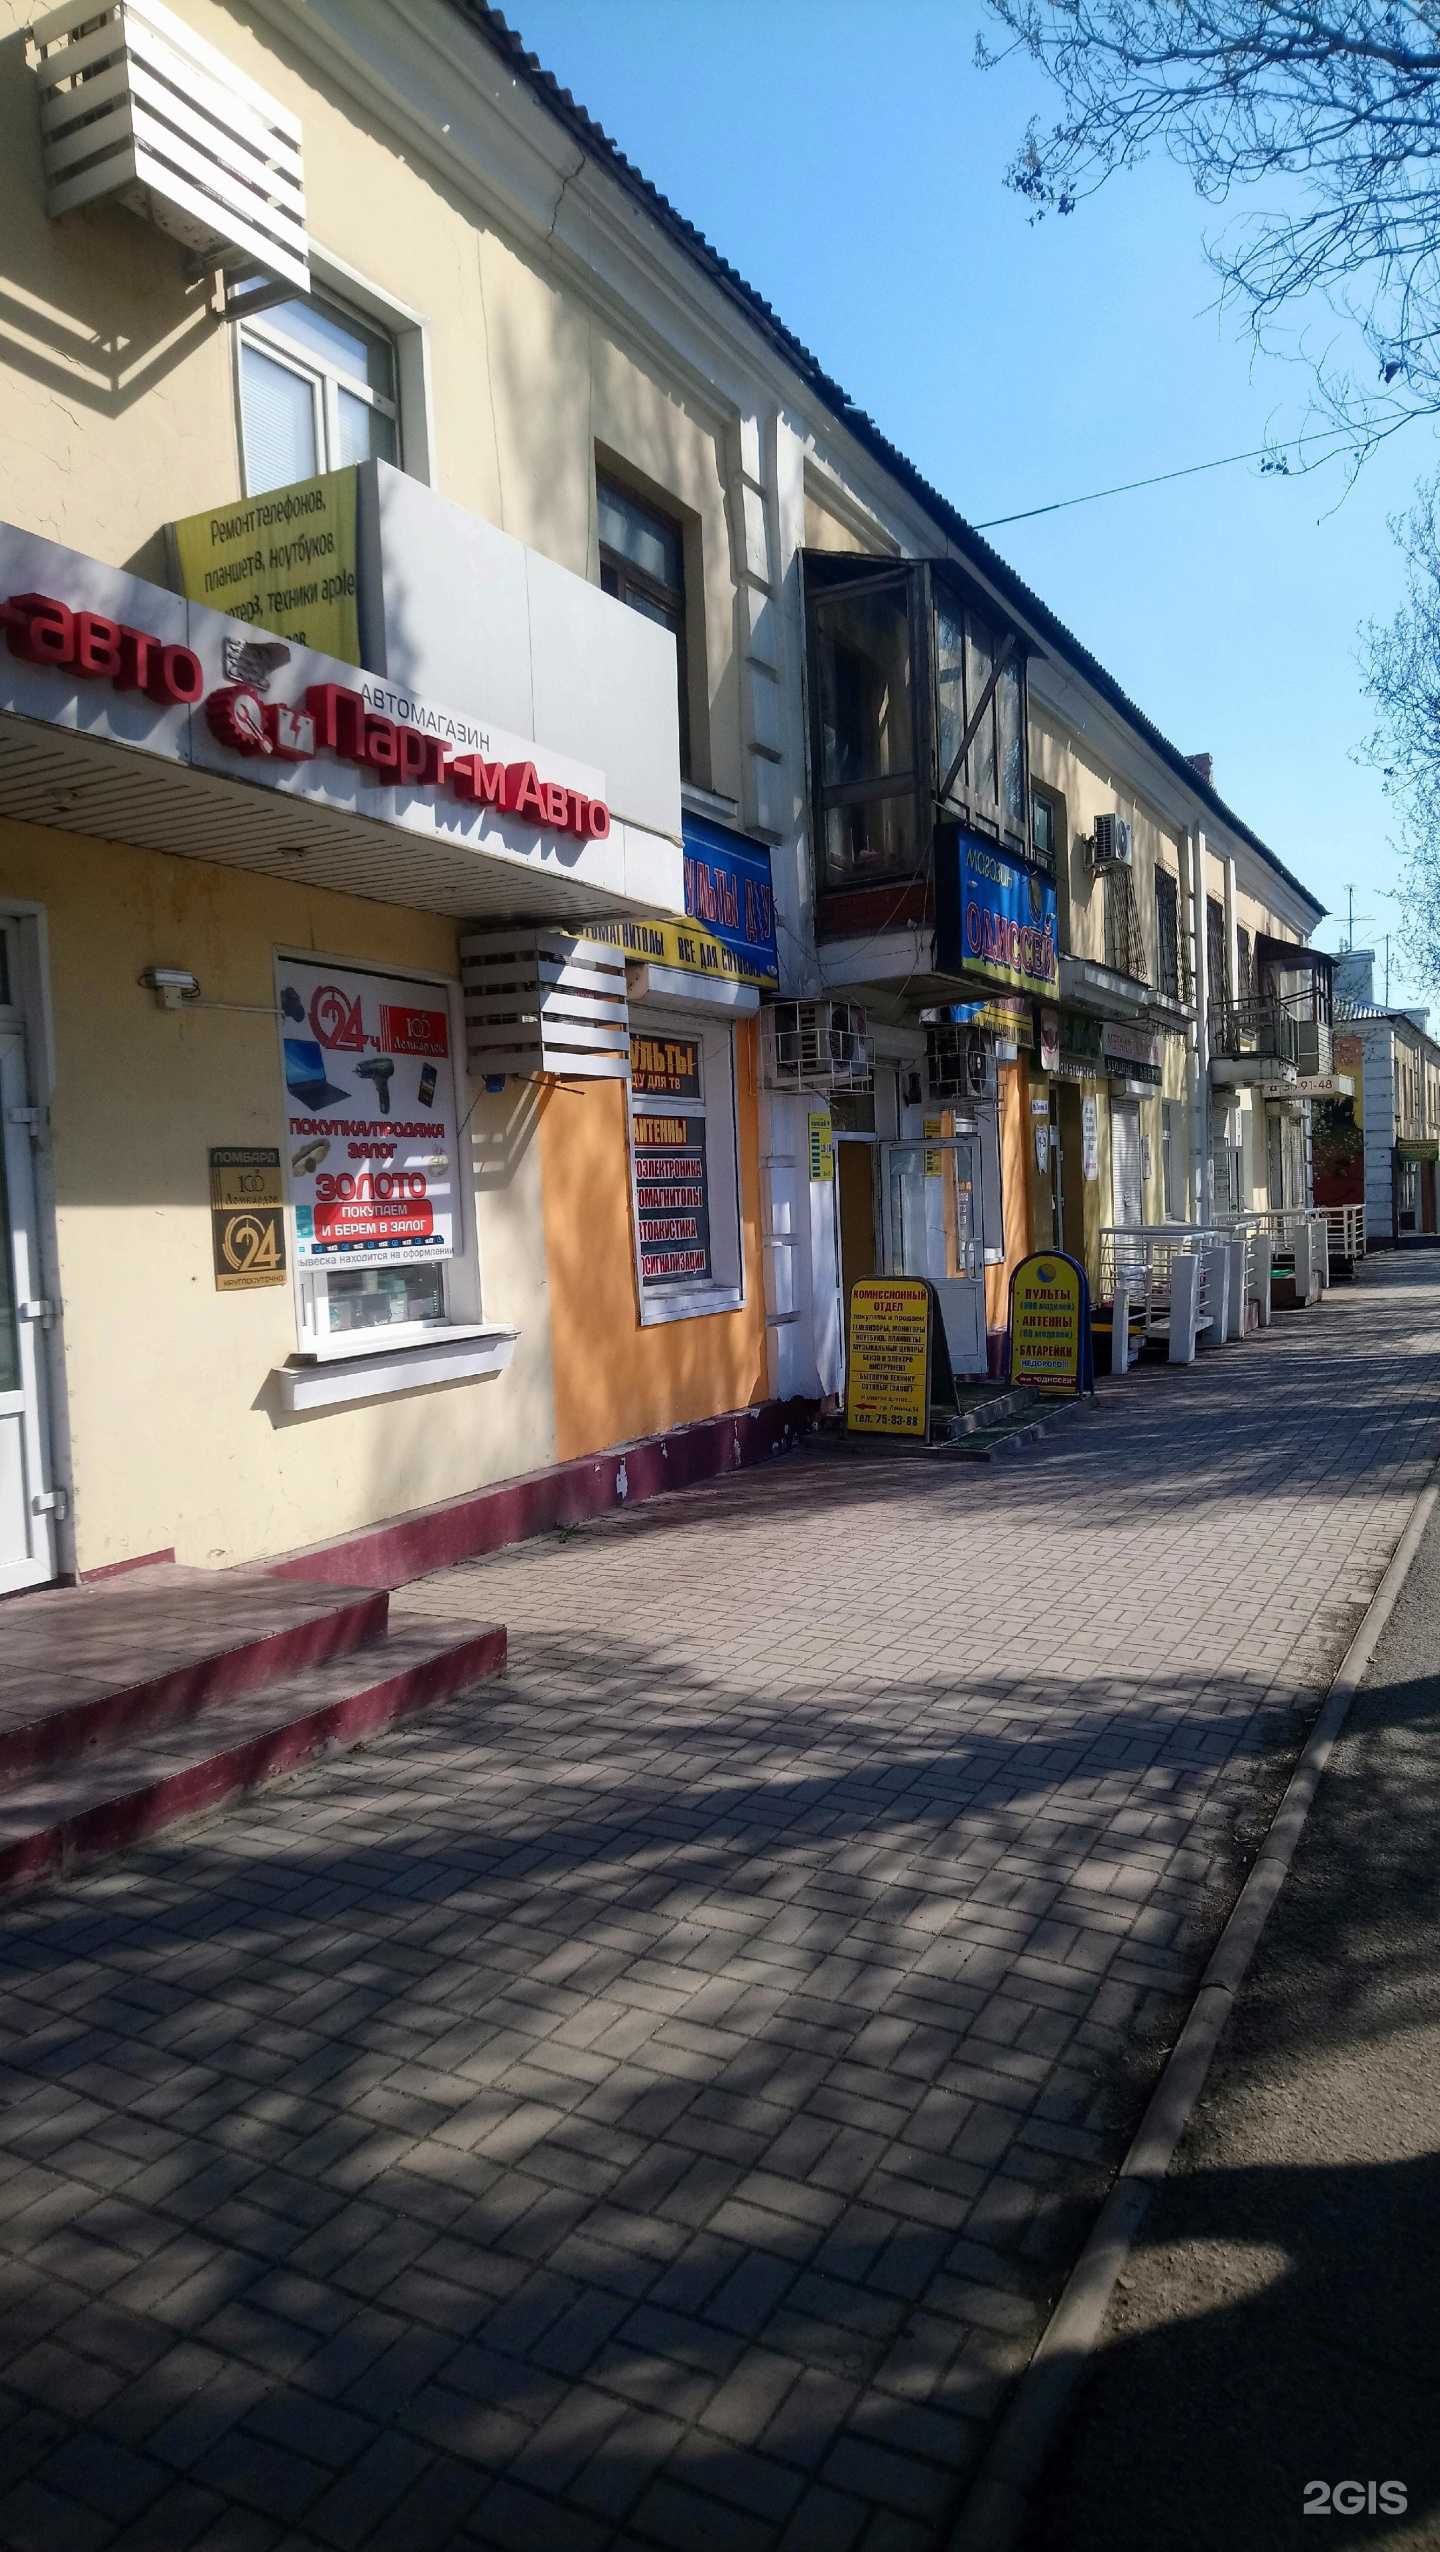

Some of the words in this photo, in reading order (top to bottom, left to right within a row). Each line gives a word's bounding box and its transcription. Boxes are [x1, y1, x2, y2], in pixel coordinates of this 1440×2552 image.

[209, 512, 256, 546] Ремонт
[256, 489, 327, 524] телефонов,
[269, 532, 335, 571] ноутбуков
[267, 583, 318, 614] техники
[321, 567, 356, 604] apple
[360, 683, 491, 752] АВТОМАГАЗИН
[683, 857, 739, 929] УЛЬТЫ
[966, 901, 1057, 980] ОДИССЕЙ
[678, 936, 697, 964] ВСЕ
[700, 943, 718, 969] ДЛЯ
[647, 1074, 666, 1091] ДЛЯ
[668, 1076, 681, 1090] ТВ
[289, 1118, 446, 1138] ПОКУПКА/ПРОДАЖА
[213, 1150, 278, 1165] ЛОМБАРД
[347, 1141, 398, 1160] ЗАЛОГ
[635, 1157, 702, 1178] ОЭЛЕКТРОНИКА
[315, 1172, 427, 1201] ЗОЛОТО
[637, 1186, 703, 1208] ОМАГНИТОЛЫ
[341, 1204, 408, 1218] ПОКУПАЕМ
[322, 1222, 331, 1237] И
[335, 1220, 377, 1236] БЕРЕМ
[380, 1220, 388, 1234] В
[390, 1219, 426, 1233] ЗАЛОГ
[226, 1214, 282, 1272] 24
[339, 1250, 389, 1266] находится
[390, 1249, 401, 1260] на
[223, 1274, 286, 1288] КРУГЛОСУТОЧНО
[853, 1289, 927, 1301] КОМИССИОННЫЙ
[1025, 1288, 1071, 1300] ПУЛЬТЫ
[873, 1302, 904, 1312] ОТДЕЛ
[1022, 1316, 1073, 1328] АНТЕННЫ
[1019, 1344, 1073, 1358] БАТАРЕЙКИ
[854, 1413, 873, 1424] тел.
